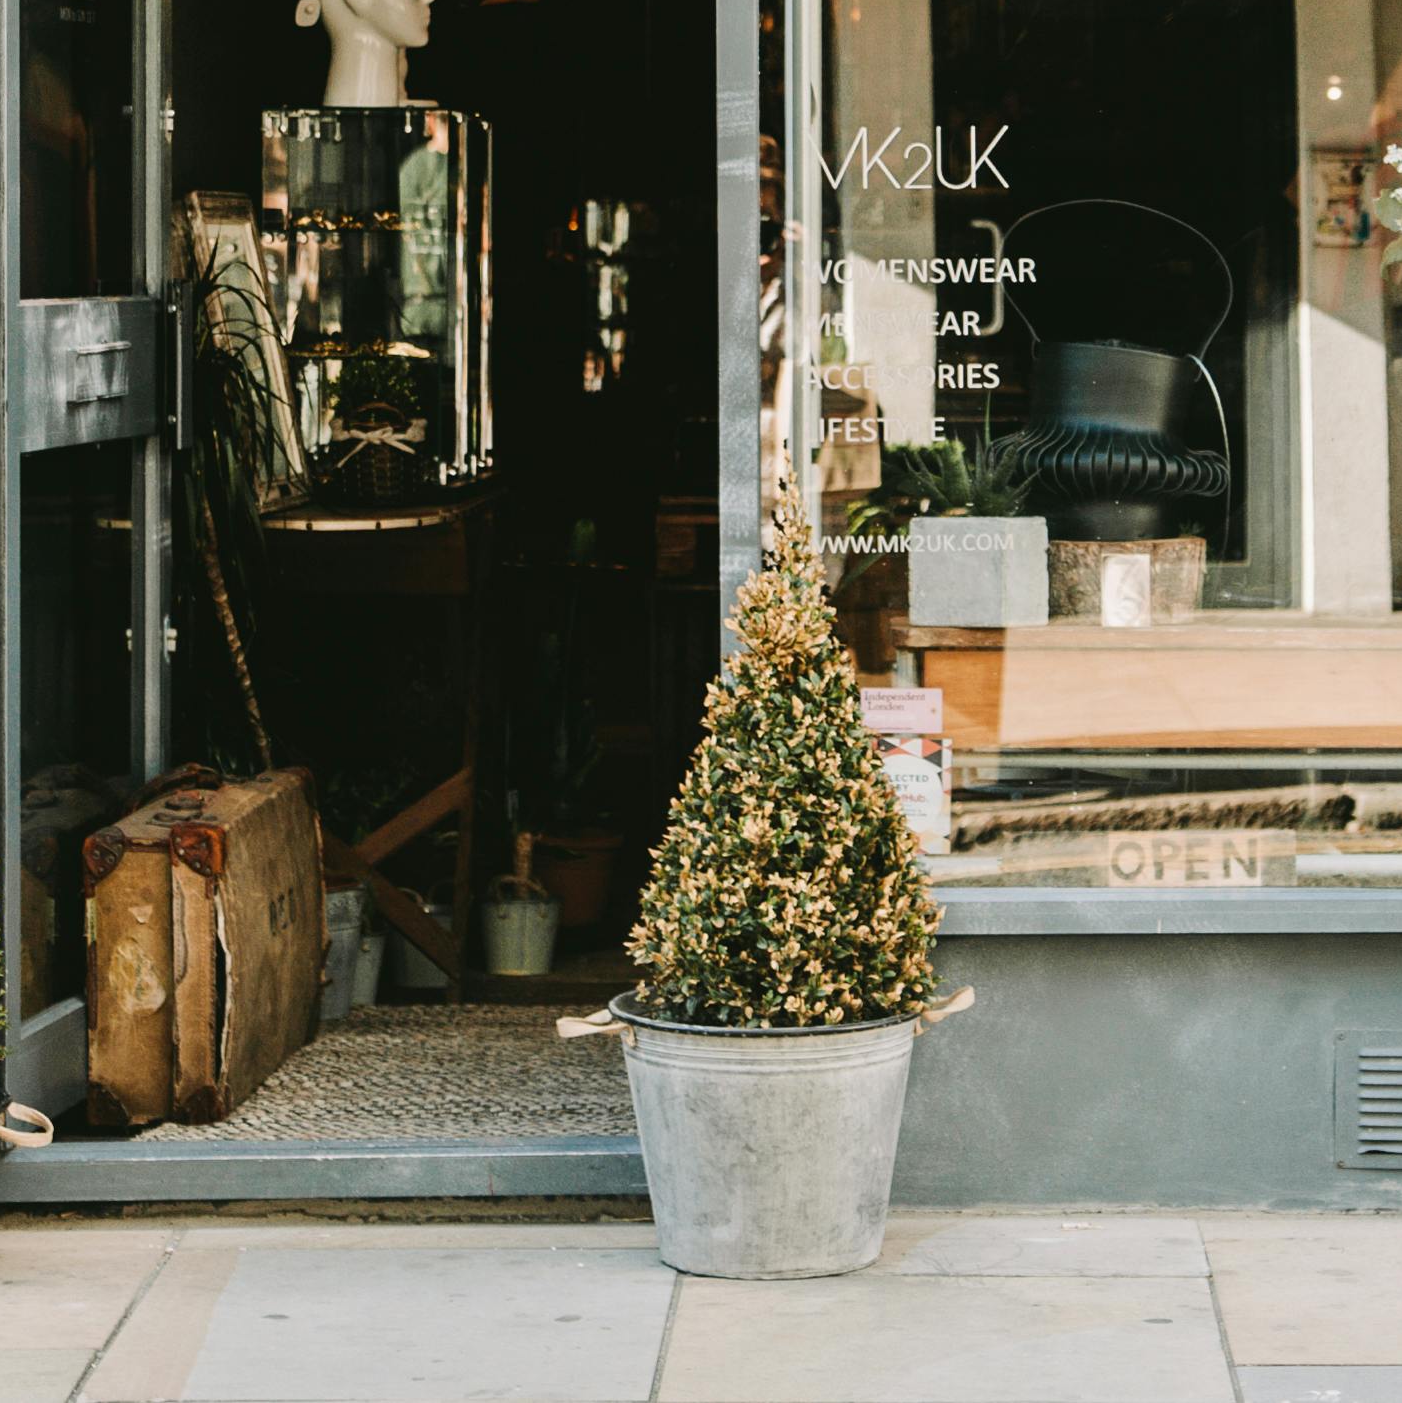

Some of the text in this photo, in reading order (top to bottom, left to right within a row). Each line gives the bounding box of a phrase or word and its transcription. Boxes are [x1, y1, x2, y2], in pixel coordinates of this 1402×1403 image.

[803, 257, 1037, 284] WOMENSWEAR
[803, 363, 1001, 390] ACCESSORIES
[864, 690, 926, 703] Independent
[868, 701, 905, 711] London
[888, 774, 929, 783] LECTED
[1111, 837, 1258, 881] OPEN
